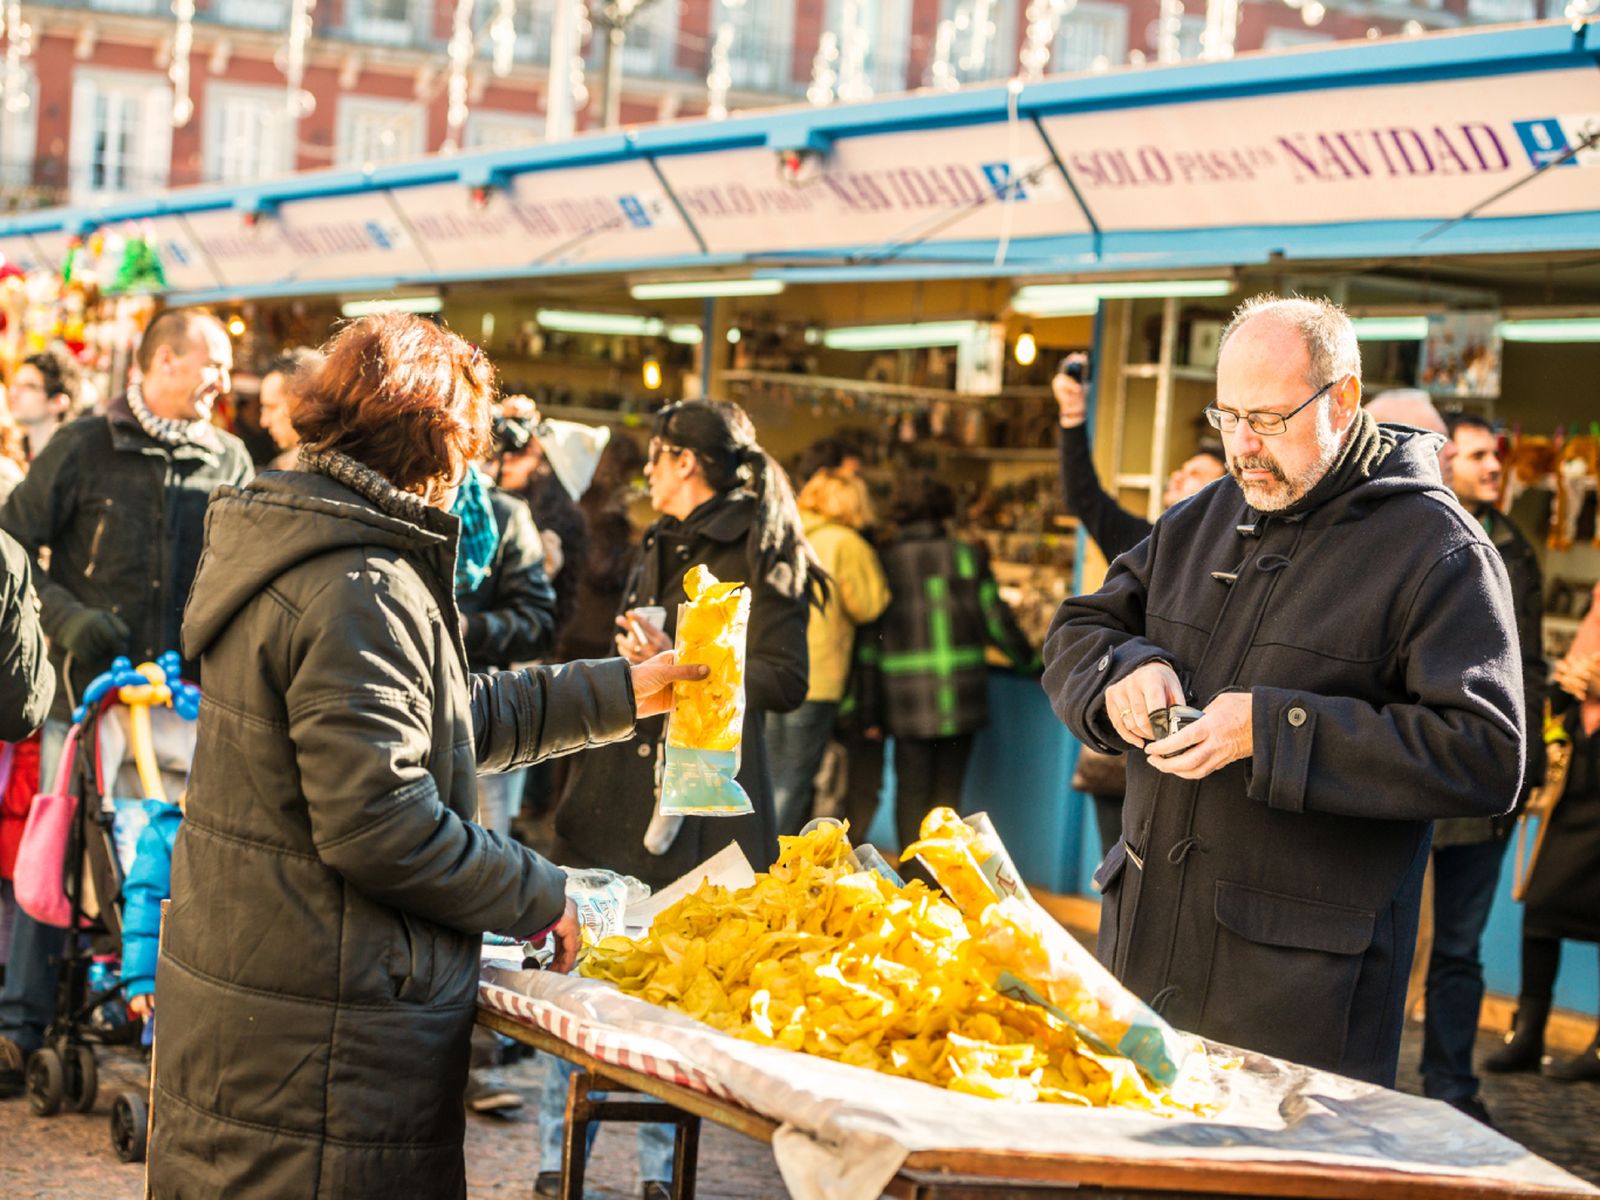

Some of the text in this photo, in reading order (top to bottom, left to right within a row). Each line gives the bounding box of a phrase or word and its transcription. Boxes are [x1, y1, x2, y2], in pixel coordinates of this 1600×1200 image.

[1070, 145, 1174, 188] SOLO
[1173, 149, 1255, 184] PASA
[1275, 120, 1511, 183] NAVIDAD
